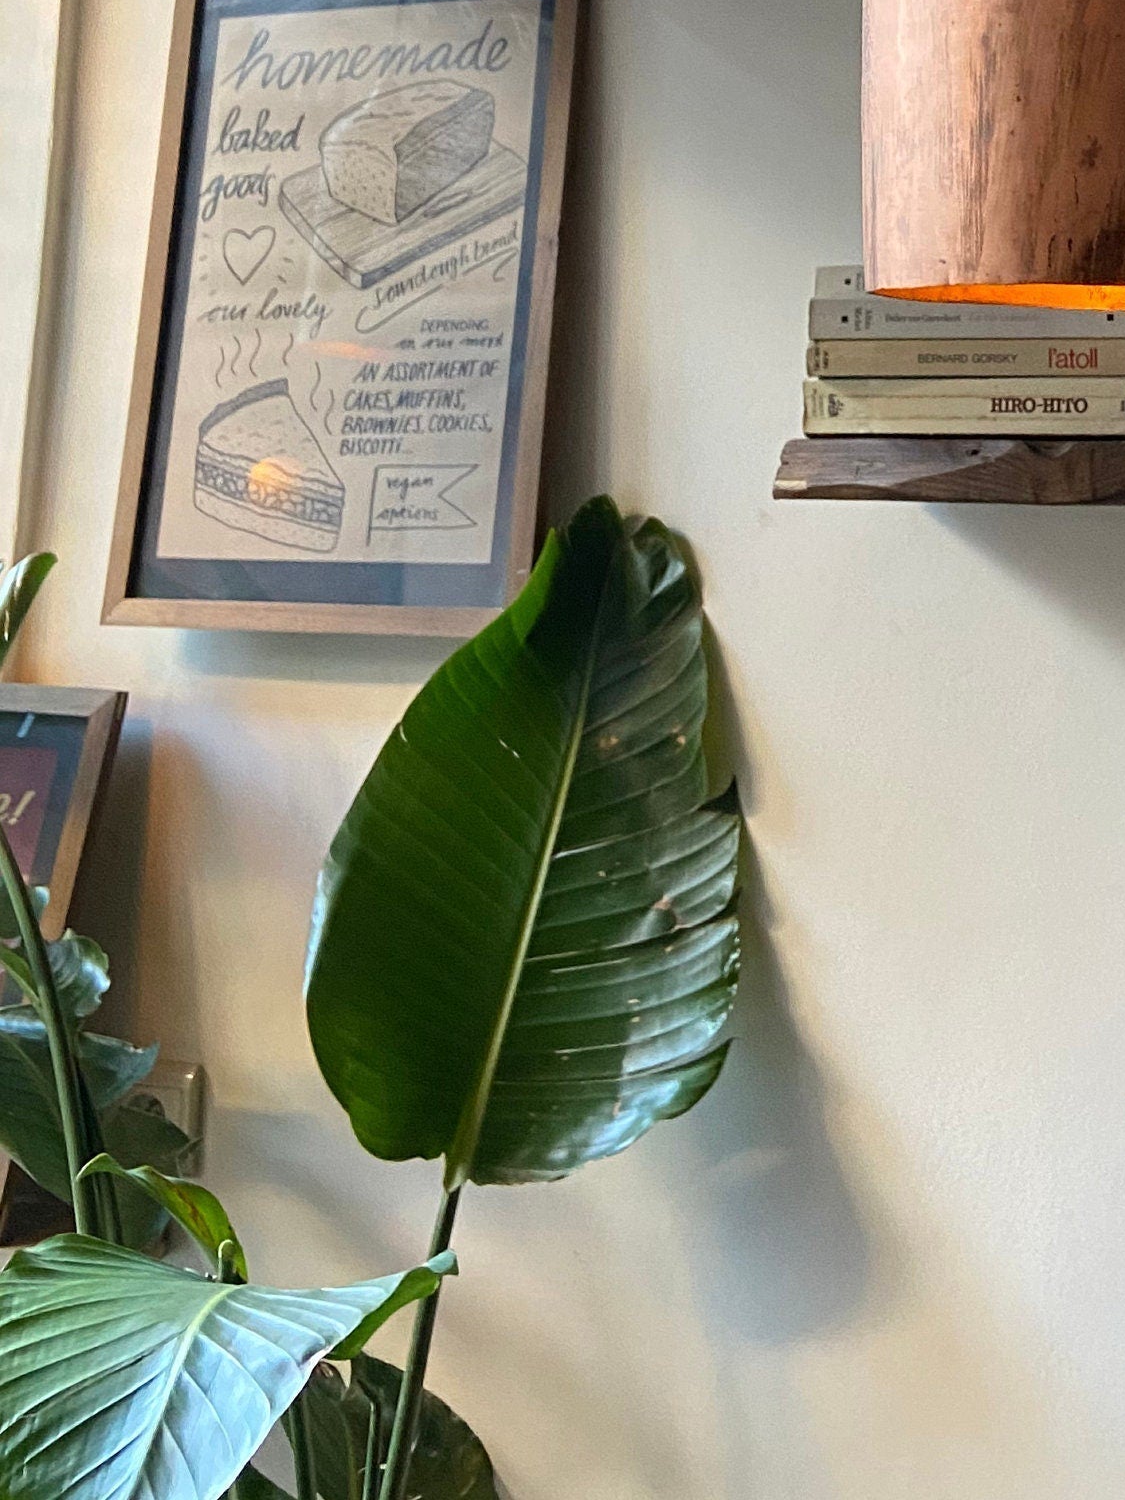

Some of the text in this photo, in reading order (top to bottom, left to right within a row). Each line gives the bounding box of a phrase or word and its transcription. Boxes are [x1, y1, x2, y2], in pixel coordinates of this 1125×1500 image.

[221, 20, 513, 91] homemade
[213, 106, 305, 155] baked
[199, 165, 277, 222] goods
[200, 287, 333, 338] our lovely
[420, 318, 490, 334] DEPENDING
[917, 351, 969, 364] BERNARD
[972, 351, 1019, 364] GORSKY
[354, 359, 500, 383] AN ASSORTMENT OF
[990, 396, 1089, 414] HIRO-HITO
[385, 476, 434, 499] vegan
[376, 503, 440, 525] options
